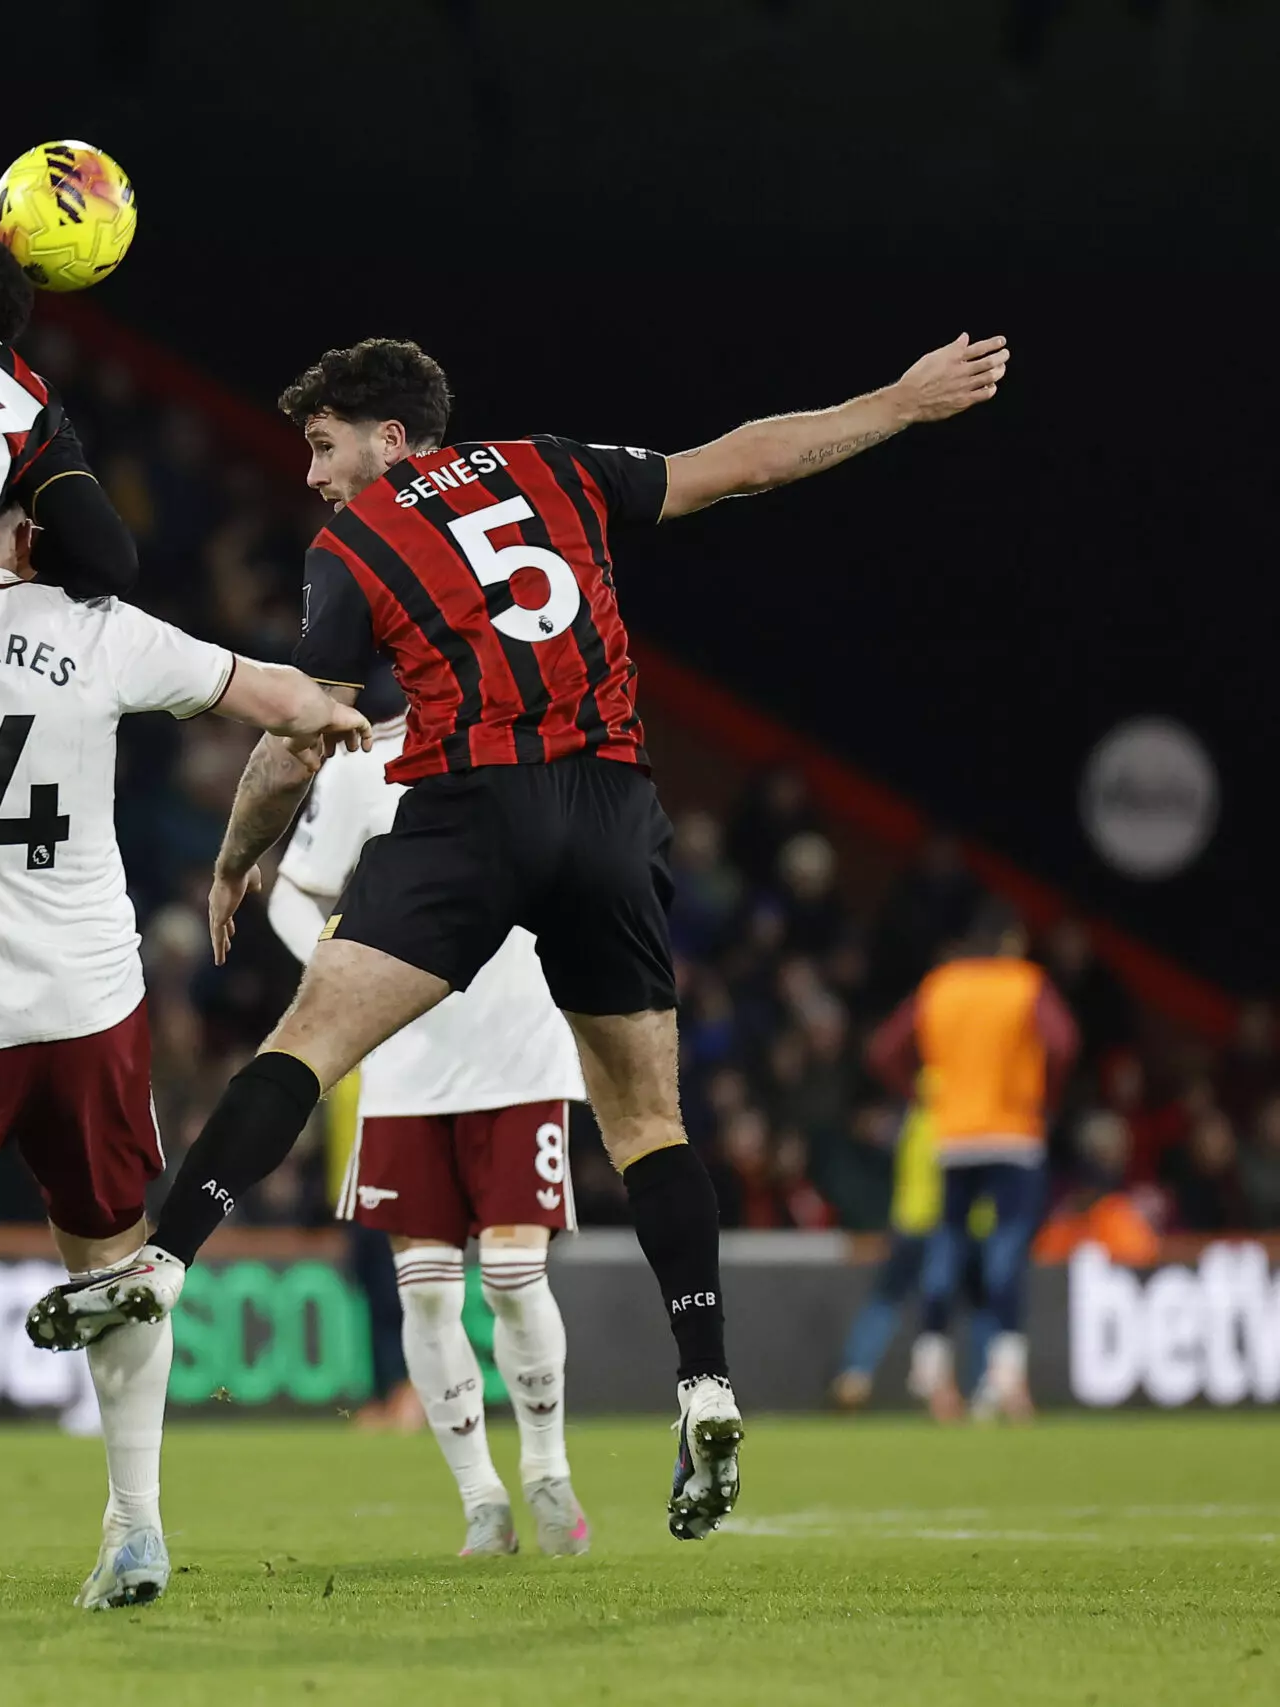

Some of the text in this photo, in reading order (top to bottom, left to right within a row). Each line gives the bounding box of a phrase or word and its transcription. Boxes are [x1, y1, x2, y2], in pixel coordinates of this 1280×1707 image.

[394, 445, 509, 508] SENESI
[446, 494, 581, 643] 5
[535, 1122, 564, 1184] 8
[672, 1291, 716, 1314] AFCB
